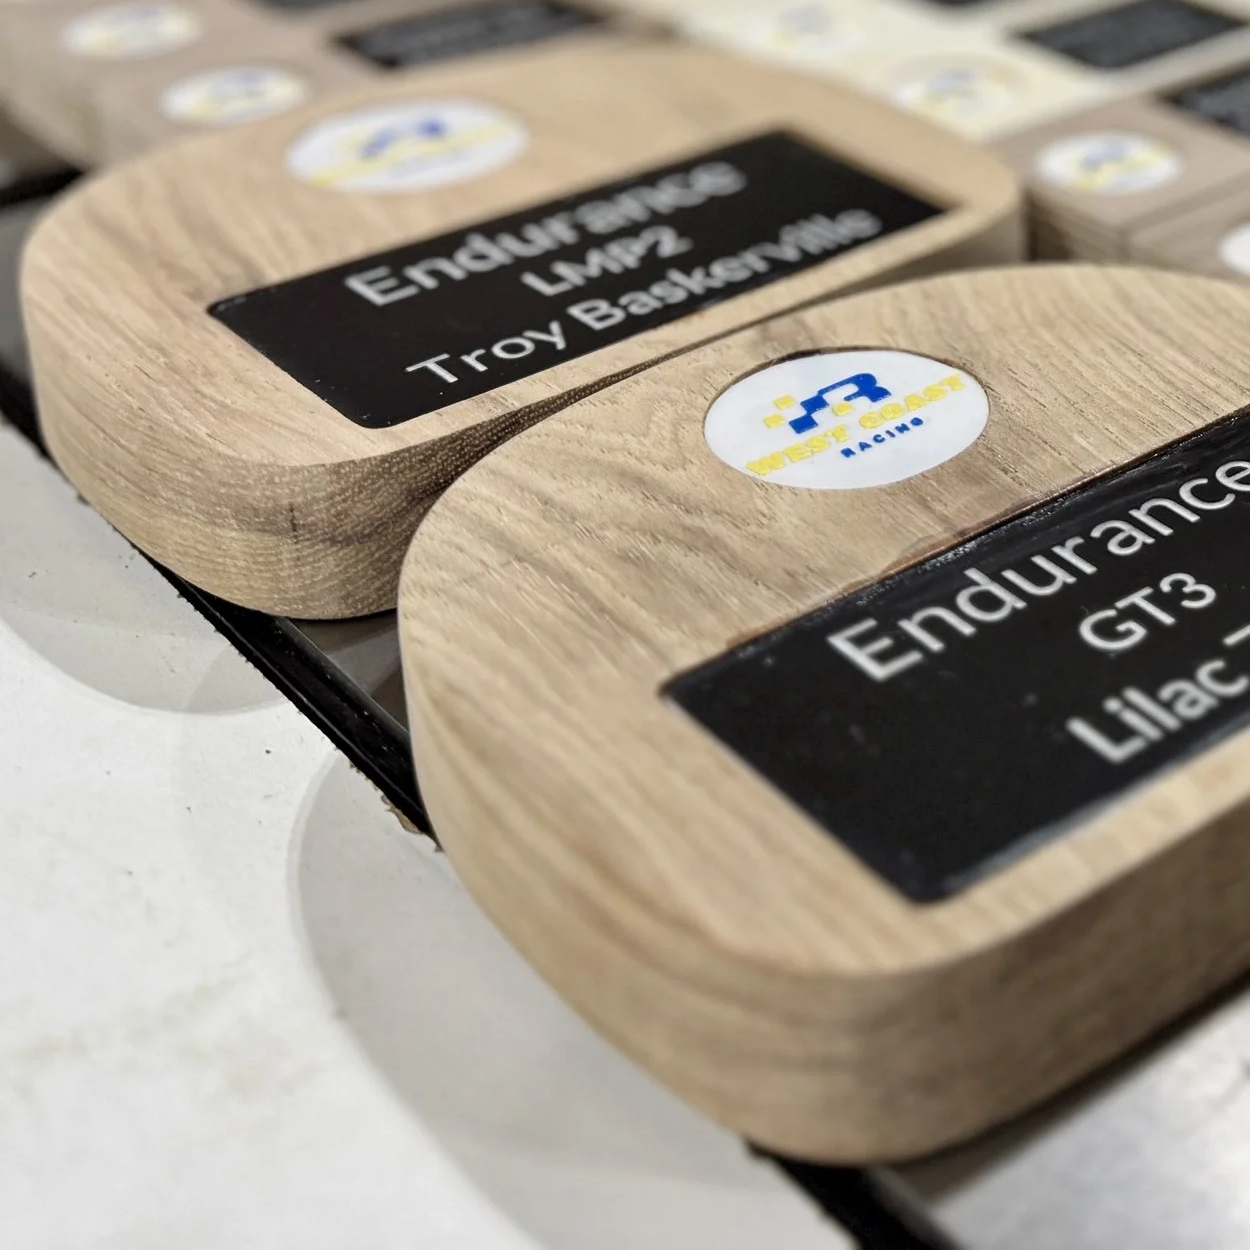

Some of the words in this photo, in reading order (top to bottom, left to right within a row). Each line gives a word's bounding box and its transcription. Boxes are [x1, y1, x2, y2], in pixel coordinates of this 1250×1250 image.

[344, 160, 748, 307] Endurance
[520, 224, 696, 298] LMP2
[406, 320, 568, 384] Troy
[566, 208, 884, 331] Baskerville
[745, 423, 851, 476] WEST
[858, 373, 966, 430] COAST
[839, 416, 925, 459] RACING
[1078, 572, 1218, 652] GT3
